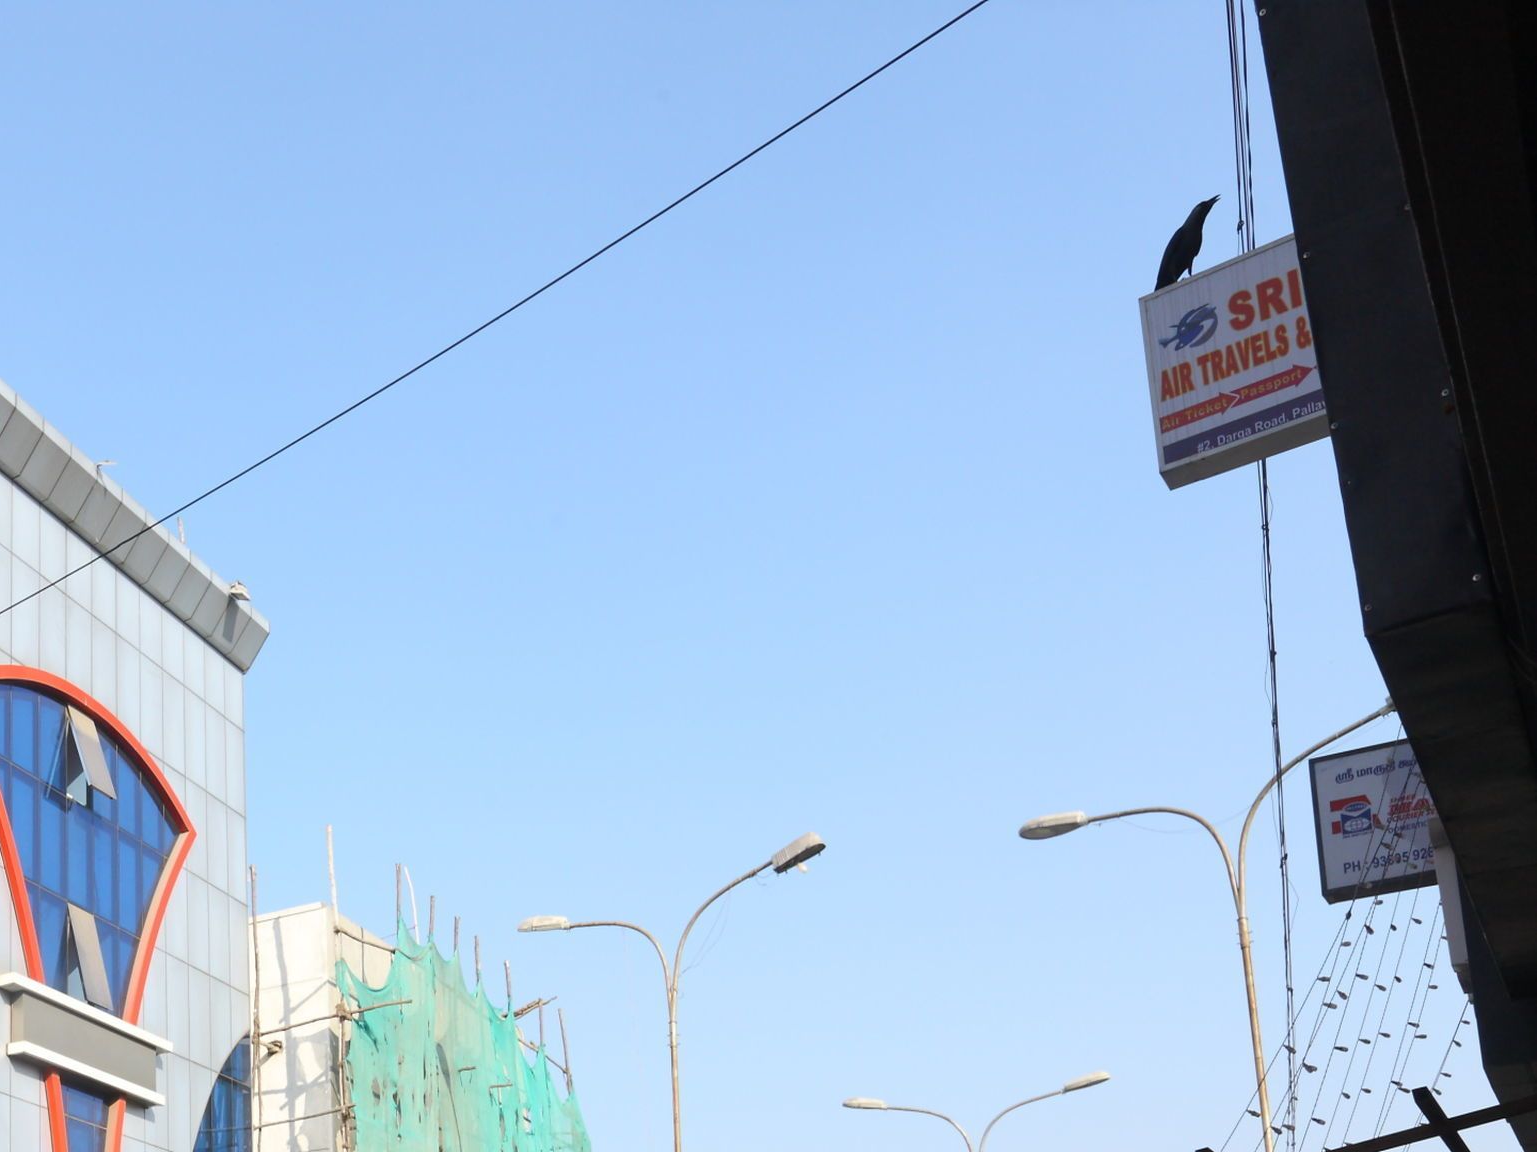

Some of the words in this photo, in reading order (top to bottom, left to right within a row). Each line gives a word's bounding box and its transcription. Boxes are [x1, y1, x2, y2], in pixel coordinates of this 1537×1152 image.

[1228, 268, 1303, 331] SRI
[1160, 360, 1196, 402] AIR
[1197, 324, 1290, 386] TRAVELS
[1295, 315, 1312, 349] &
[1162, 415, 1180, 430] Air
[1185, 398, 1228, 421] Ticket
[1240, 370, 1303, 399] Passport
